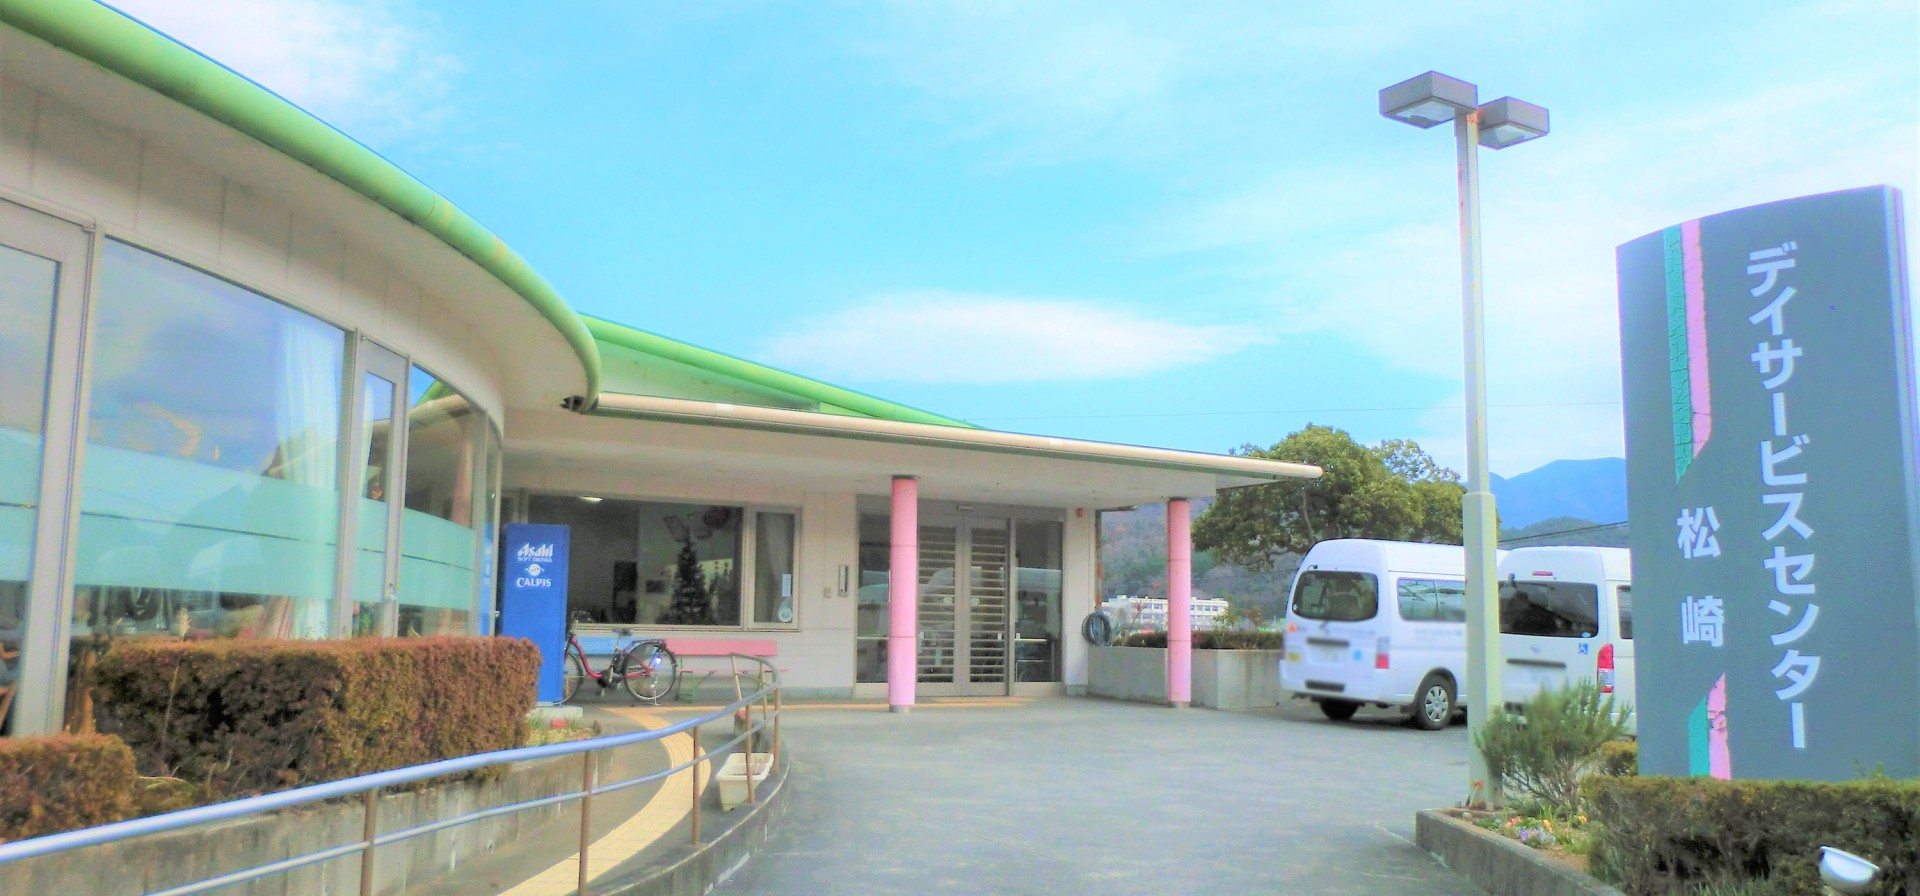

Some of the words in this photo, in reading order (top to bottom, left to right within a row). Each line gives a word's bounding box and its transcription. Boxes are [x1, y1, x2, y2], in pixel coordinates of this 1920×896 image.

[1745, 241, 1821, 749] デイサービスセンター
[516, 577, 552, 588] CALPIS
[517, 543, 554, 557] Asahi
[1677, 506, 1724, 648] 松崎
